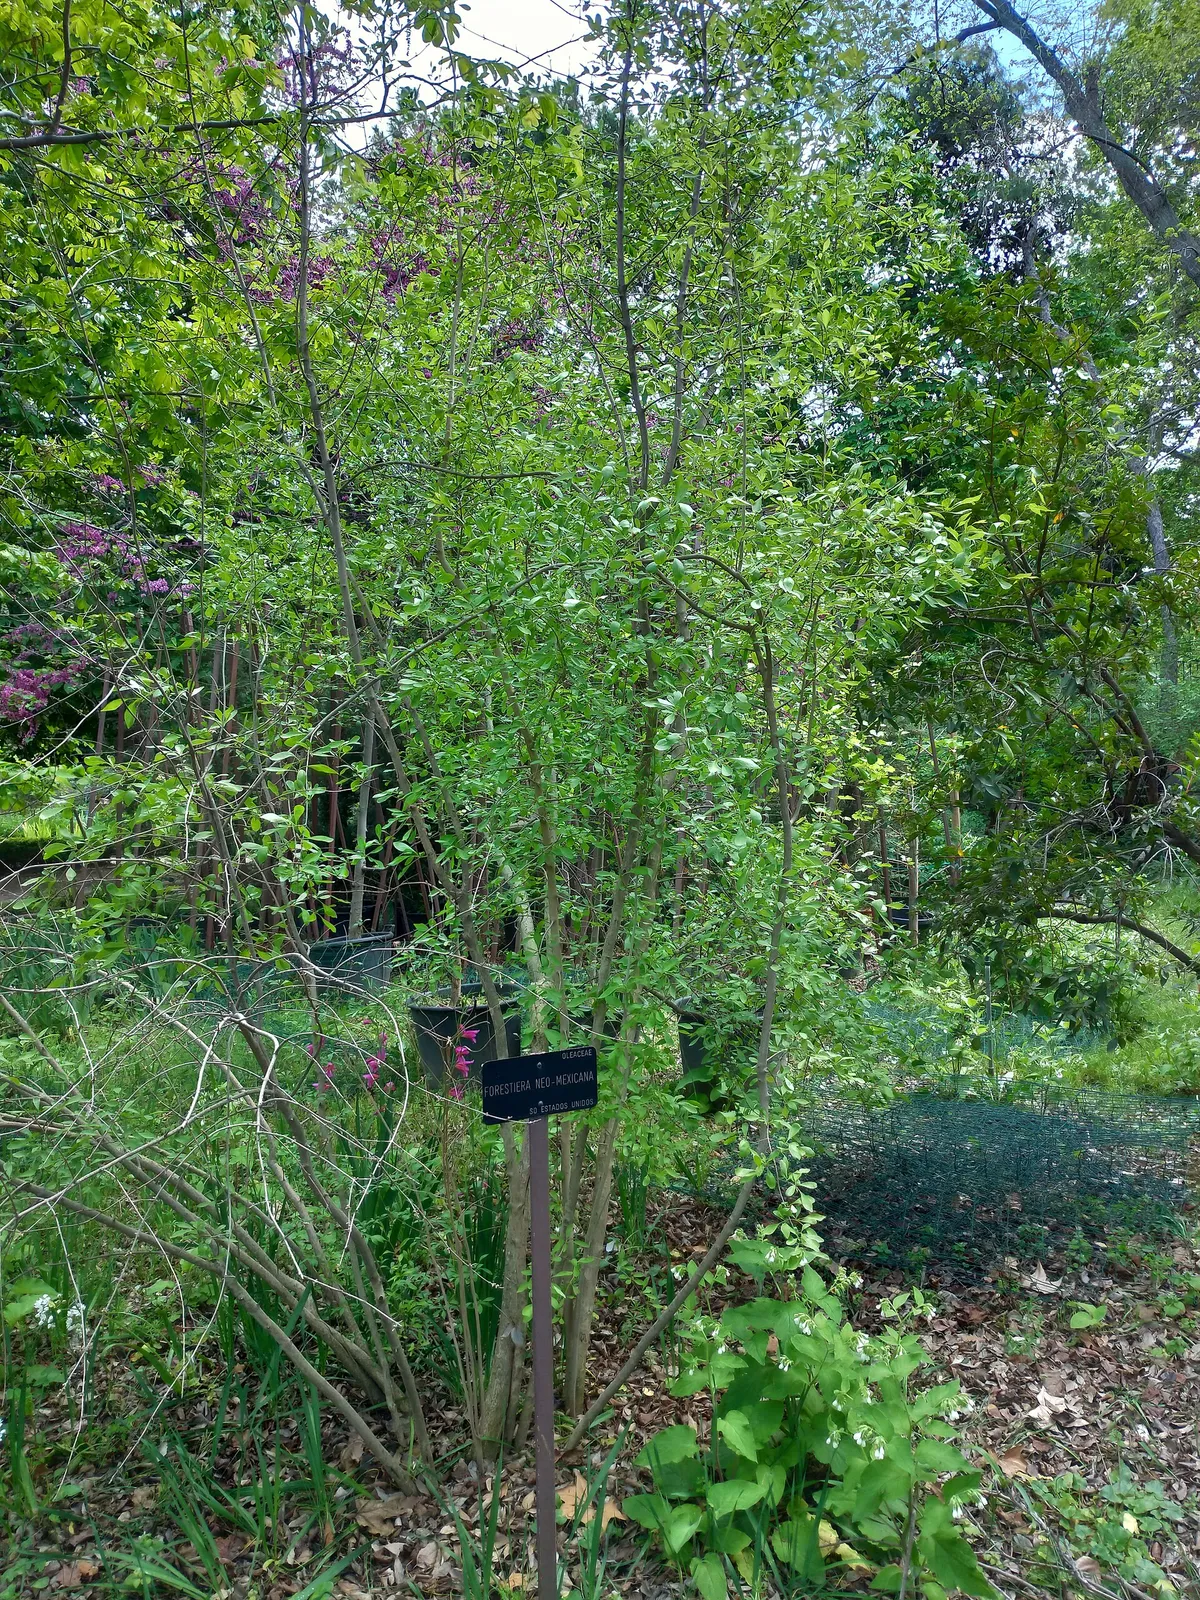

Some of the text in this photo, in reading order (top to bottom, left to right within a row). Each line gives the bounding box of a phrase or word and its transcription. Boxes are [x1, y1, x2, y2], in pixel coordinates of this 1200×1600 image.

[562, 1049, 592, 1060] OLEACEAE
[484, 1071, 594, 1097] FORESTIERA NEO-MEXICANA
[529, 1098, 594, 1115] SO ESTADOS UNIDOS
